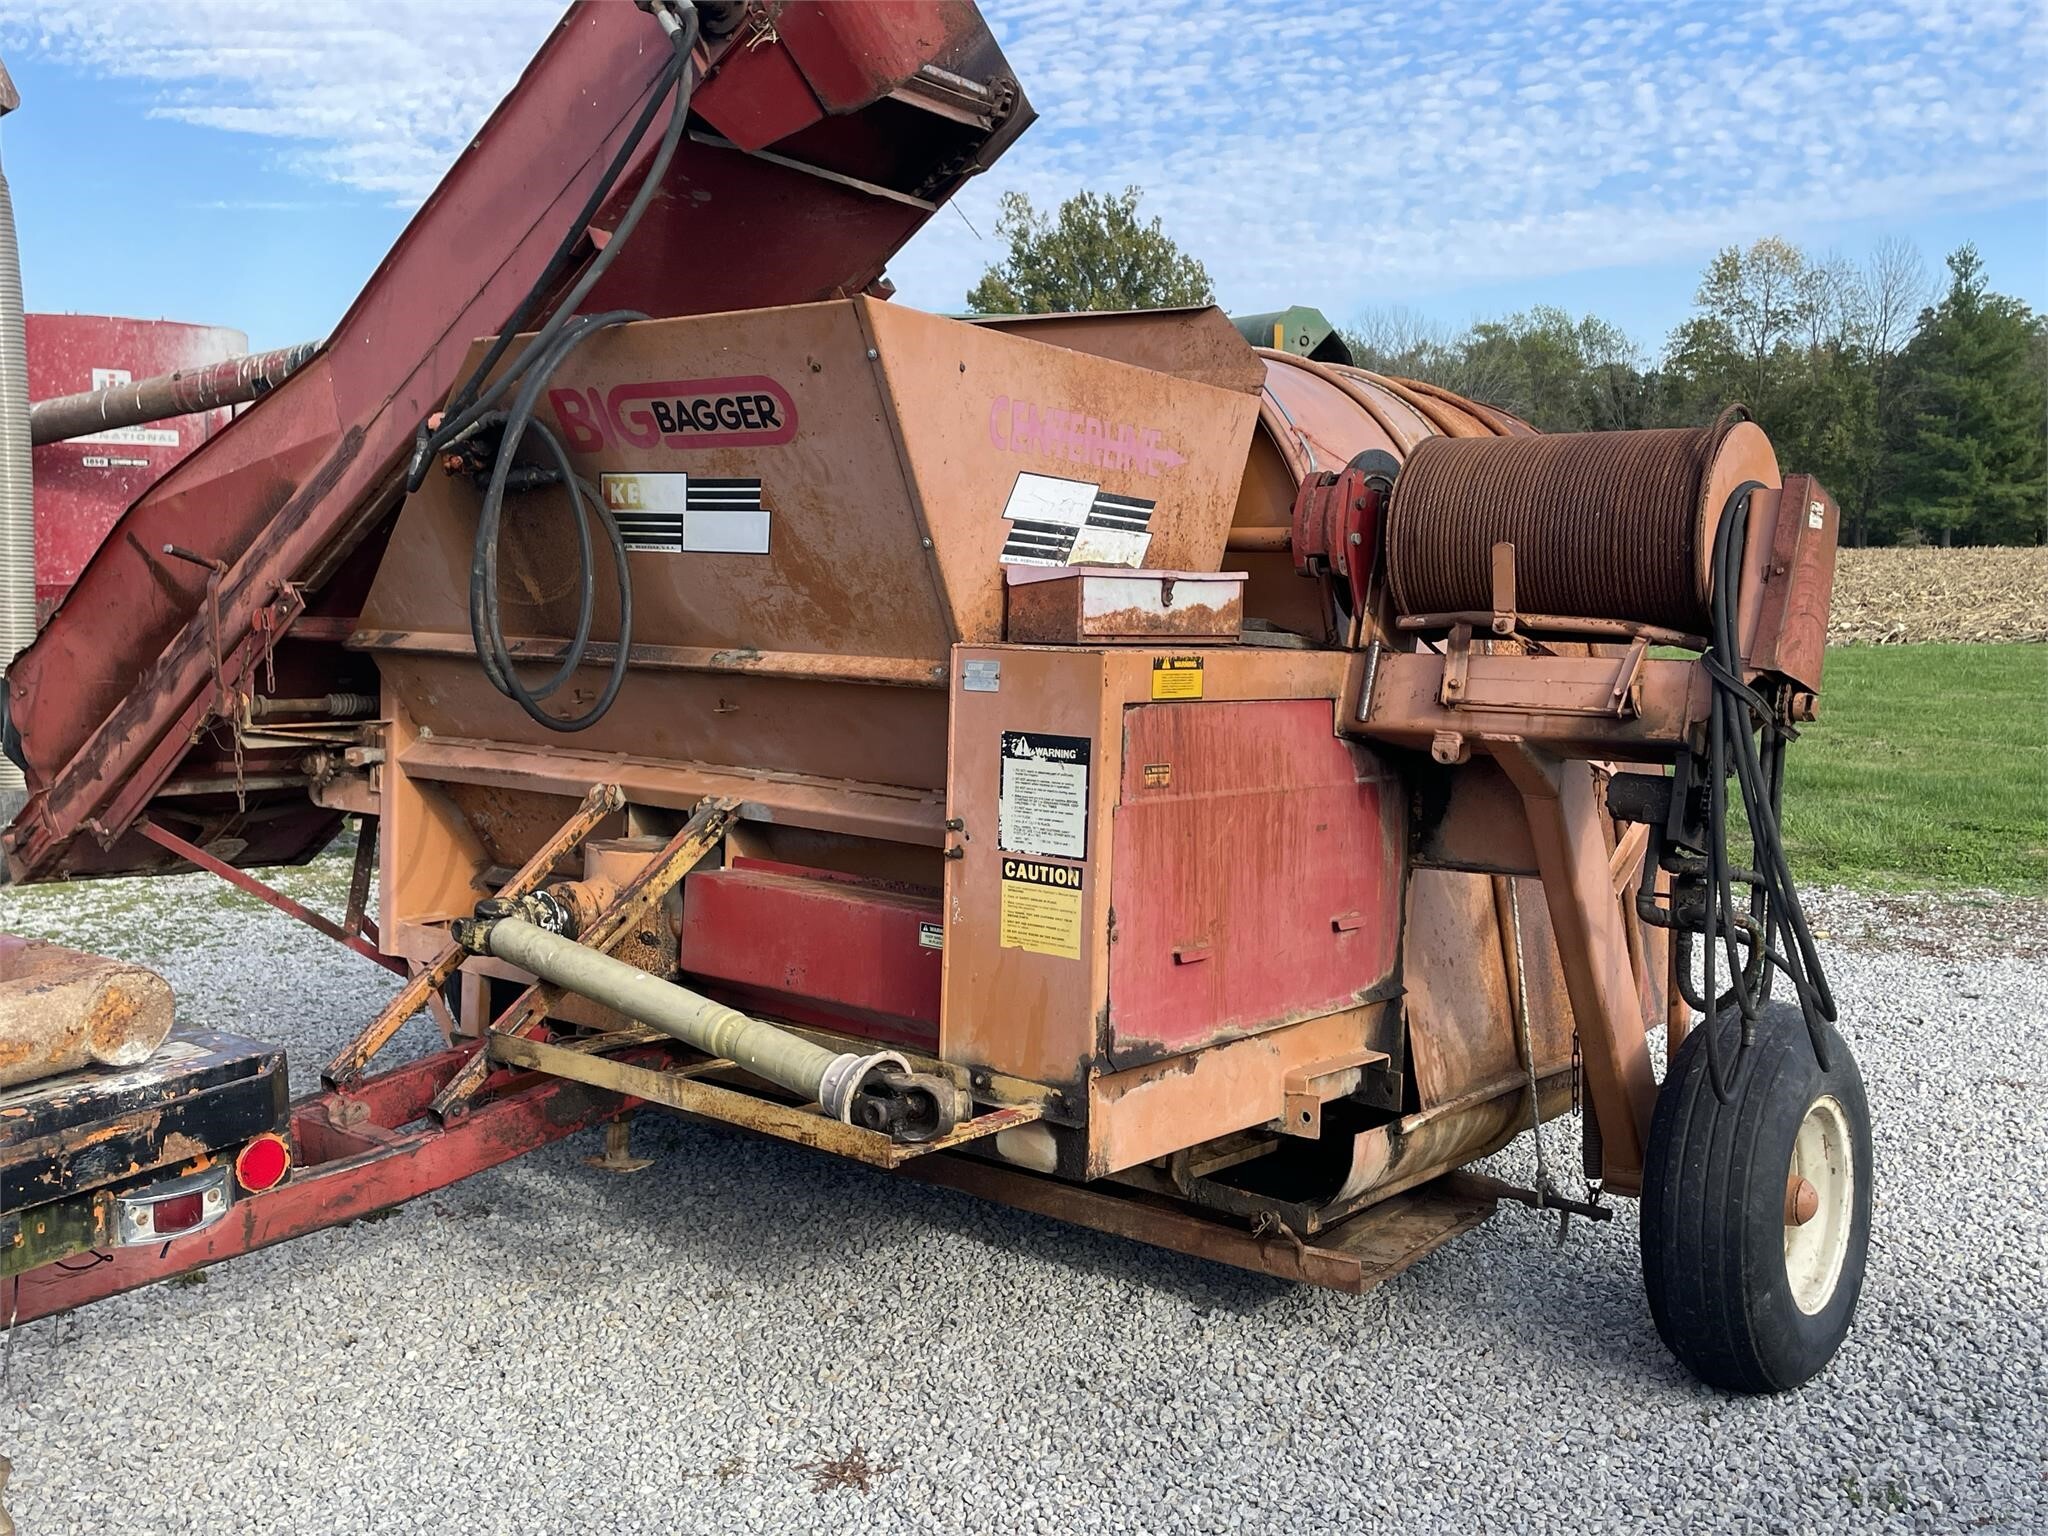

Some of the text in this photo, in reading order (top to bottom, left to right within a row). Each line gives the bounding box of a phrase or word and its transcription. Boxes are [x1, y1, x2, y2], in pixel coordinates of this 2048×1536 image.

[549, 385, 781, 452] BIG BAGGER
[1035, 746, 1076, 759] WARNING
[1005, 862, 1079, 887] CAUTION
